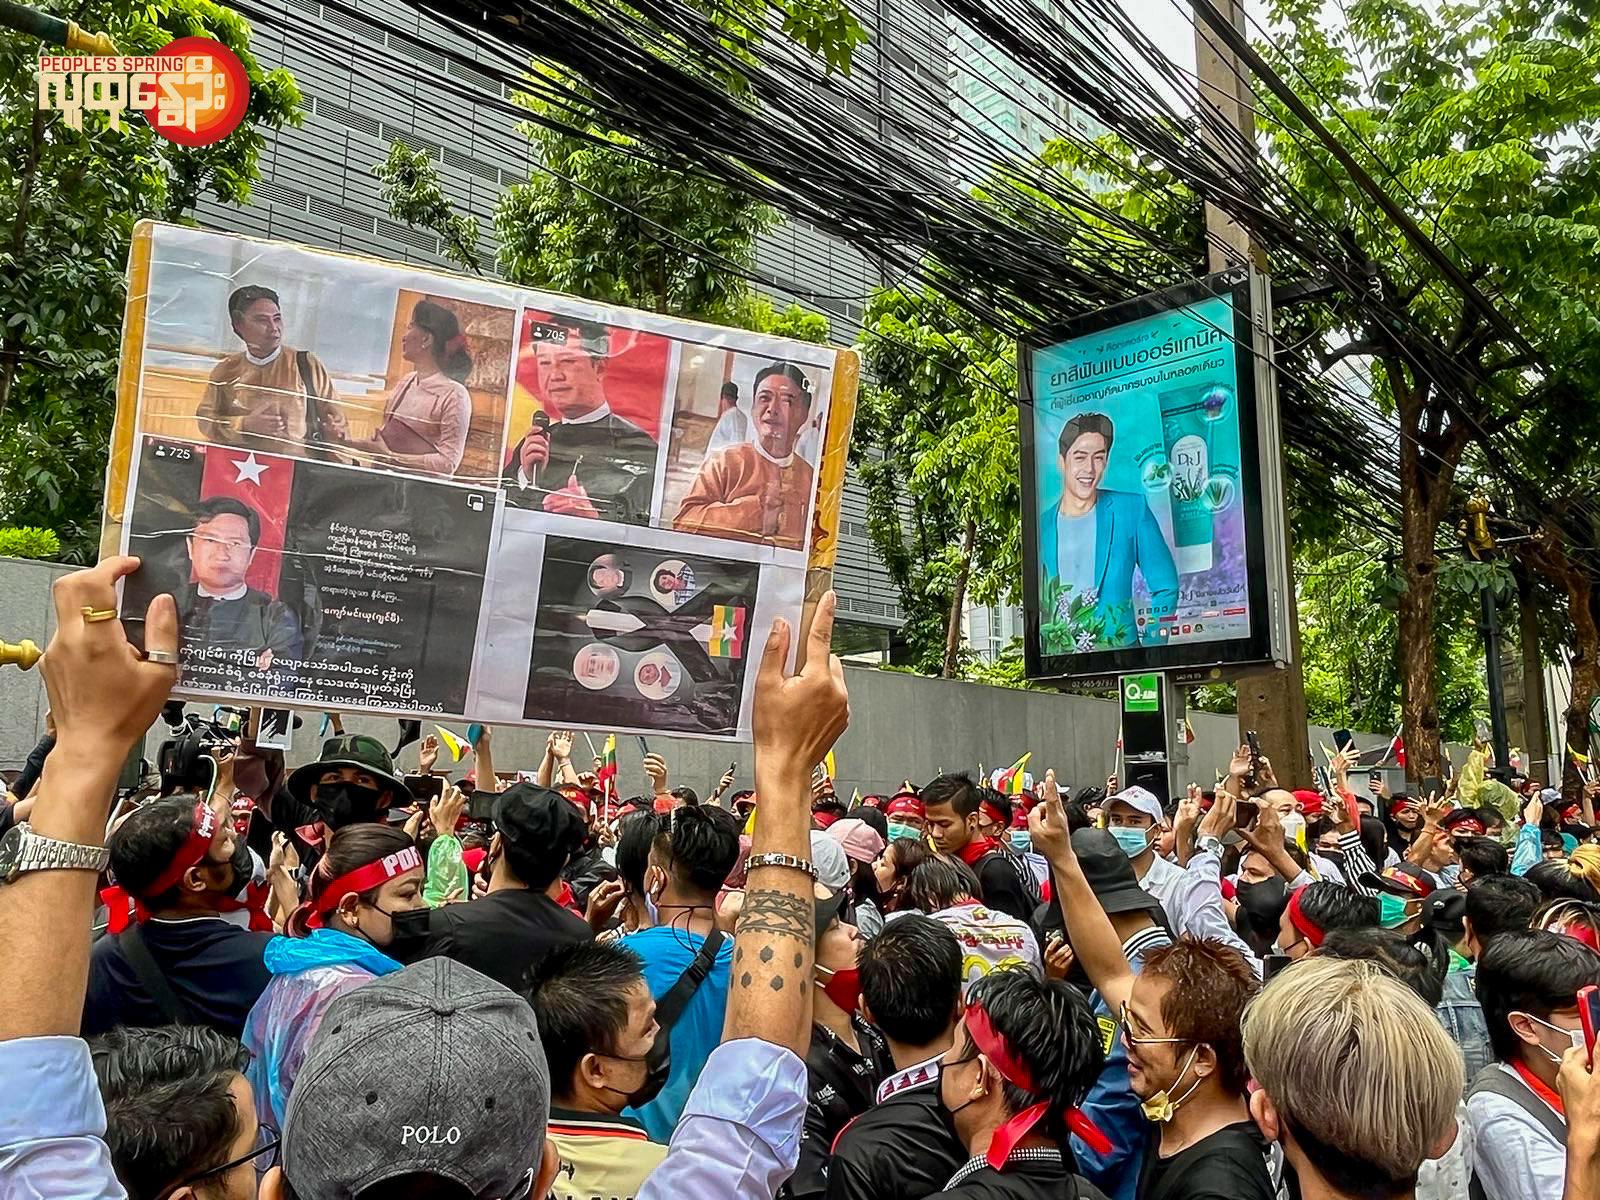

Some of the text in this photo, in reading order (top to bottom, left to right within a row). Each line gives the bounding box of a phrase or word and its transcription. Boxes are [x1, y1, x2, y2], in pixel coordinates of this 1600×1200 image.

[546, 329, 566, 342] 705
[169, 447, 191, 460] 725
[401, 1125, 461, 1145] POLO
